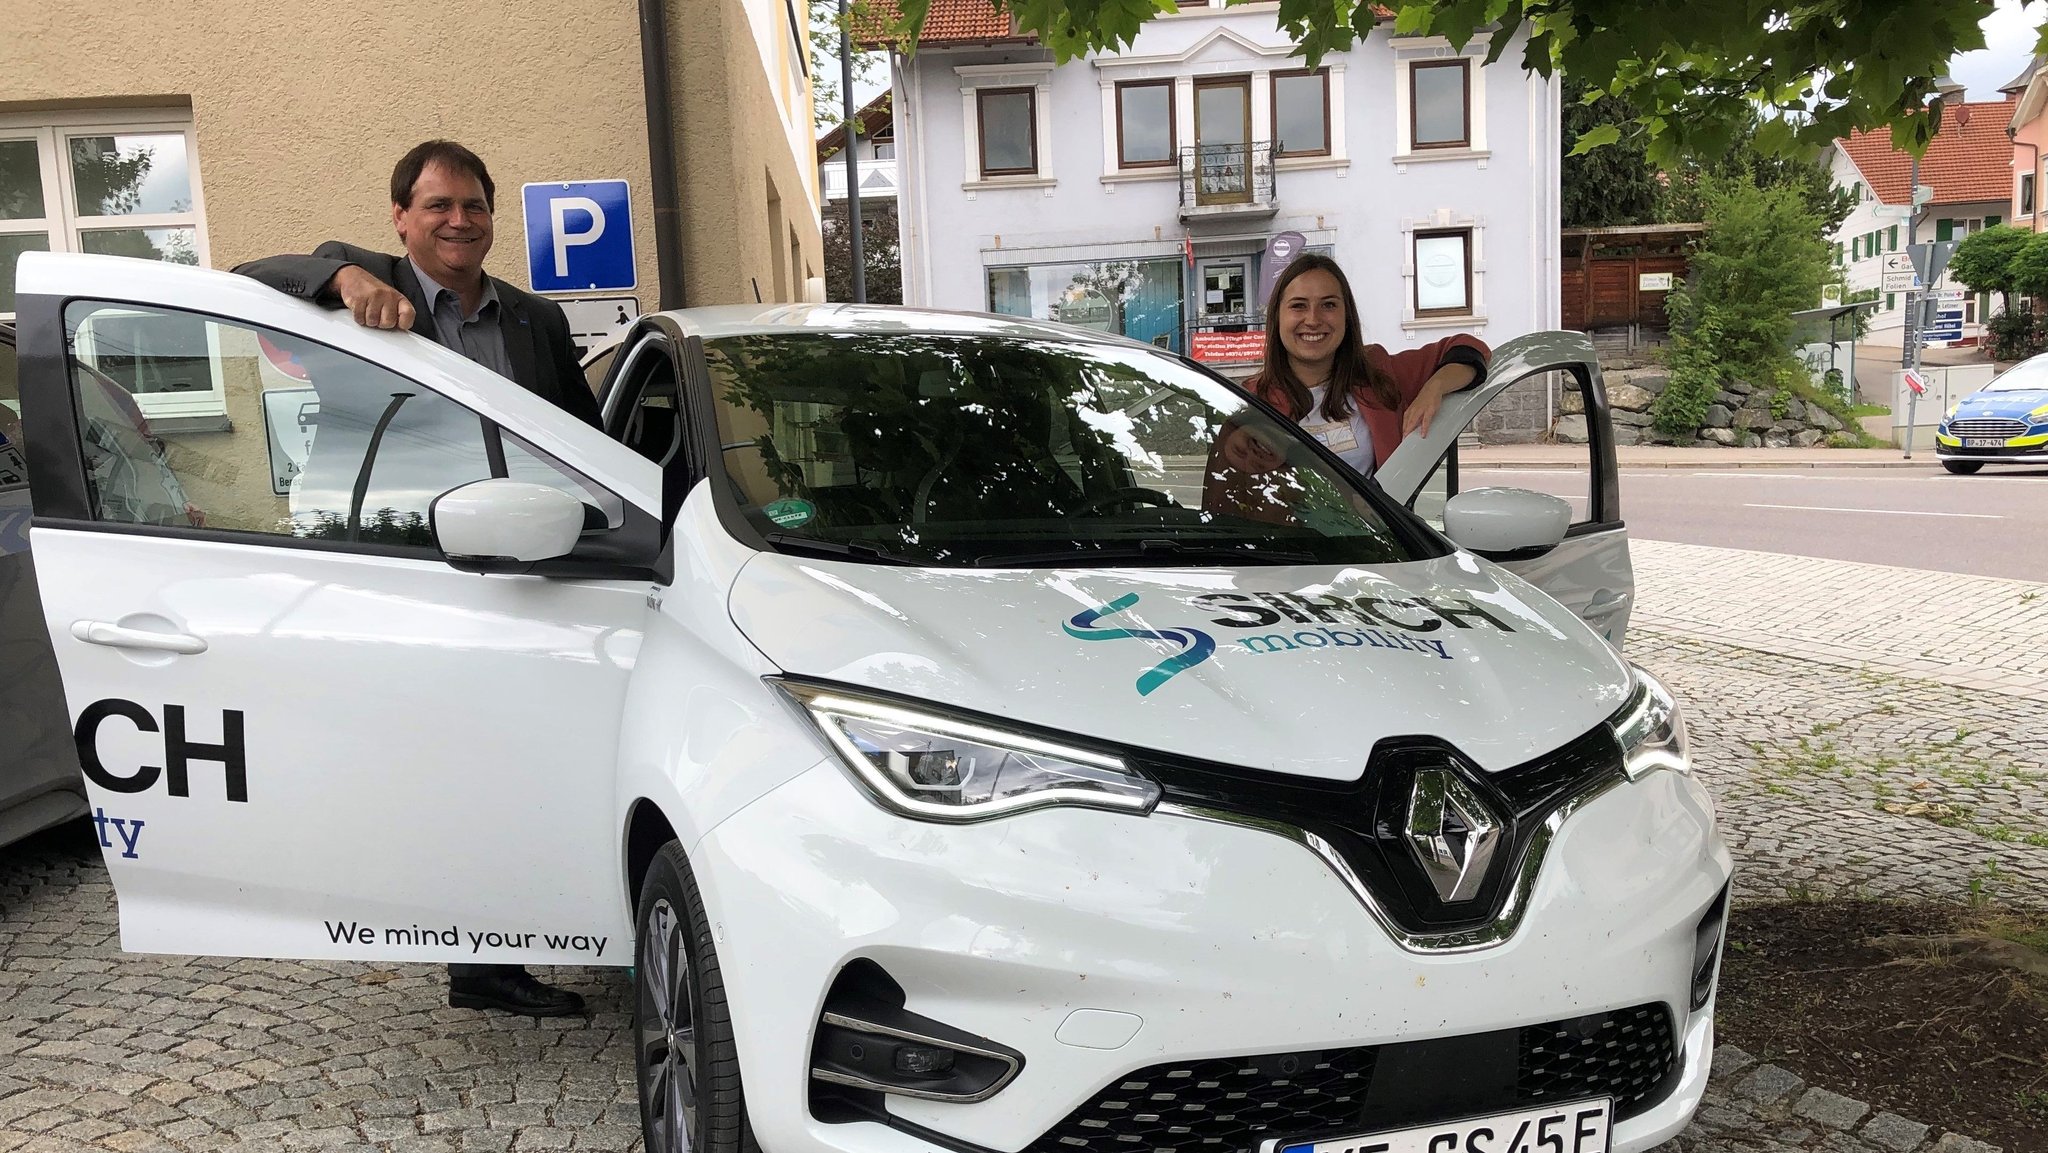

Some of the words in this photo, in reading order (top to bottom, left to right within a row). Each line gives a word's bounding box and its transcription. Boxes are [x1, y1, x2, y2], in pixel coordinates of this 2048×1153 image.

[549, 197, 606, 277] P
[1886, 275, 1912, 283] Schmid
[1886, 282, 1907, 290] Folien
[1192, 592, 1516, 633] SIRCH
[1237, 627, 1454, 660] mobility
[324, 920, 376, 945] We
[385, 924, 460, 947] mind
[467, 932, 537, 954] your
[543, 934, 608, 957] way
[1433, 932, 1481, 949] ZOE
